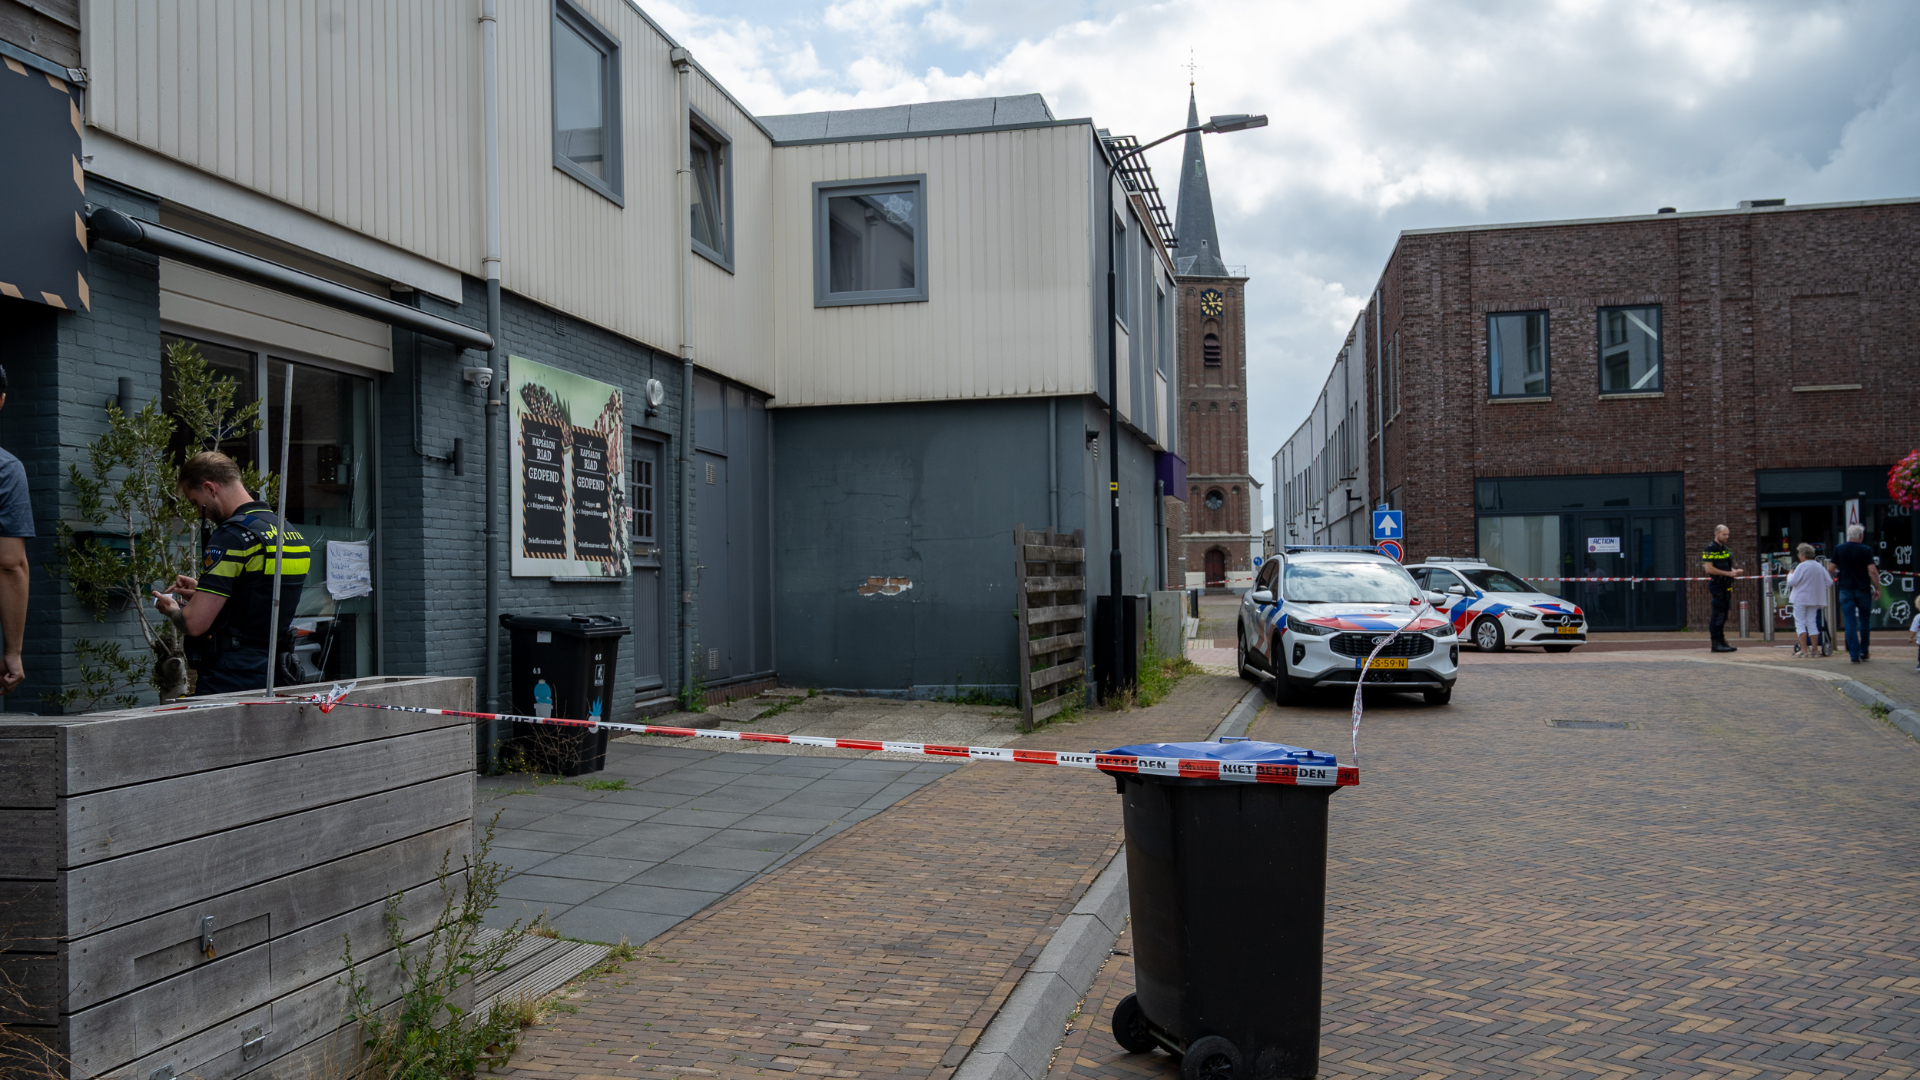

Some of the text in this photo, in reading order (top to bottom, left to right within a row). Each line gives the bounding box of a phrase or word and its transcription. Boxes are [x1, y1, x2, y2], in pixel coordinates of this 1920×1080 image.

[531, 437, 556, 450] KAPSALON
[536, 448, 552, 462] RIAD
[580, 448, 601, 460] KAPSALON
[584, 458, 598, 471] RIAD
[528, 467, 560, 483] GEOPEND
[576, 476, 605, 491] GEOPEND
[265, 530, 304, 541] PLITIE
[1060, 755, 1092, 763] NIET
[1223, 764, 1326, 778] NIET BETREDEN
